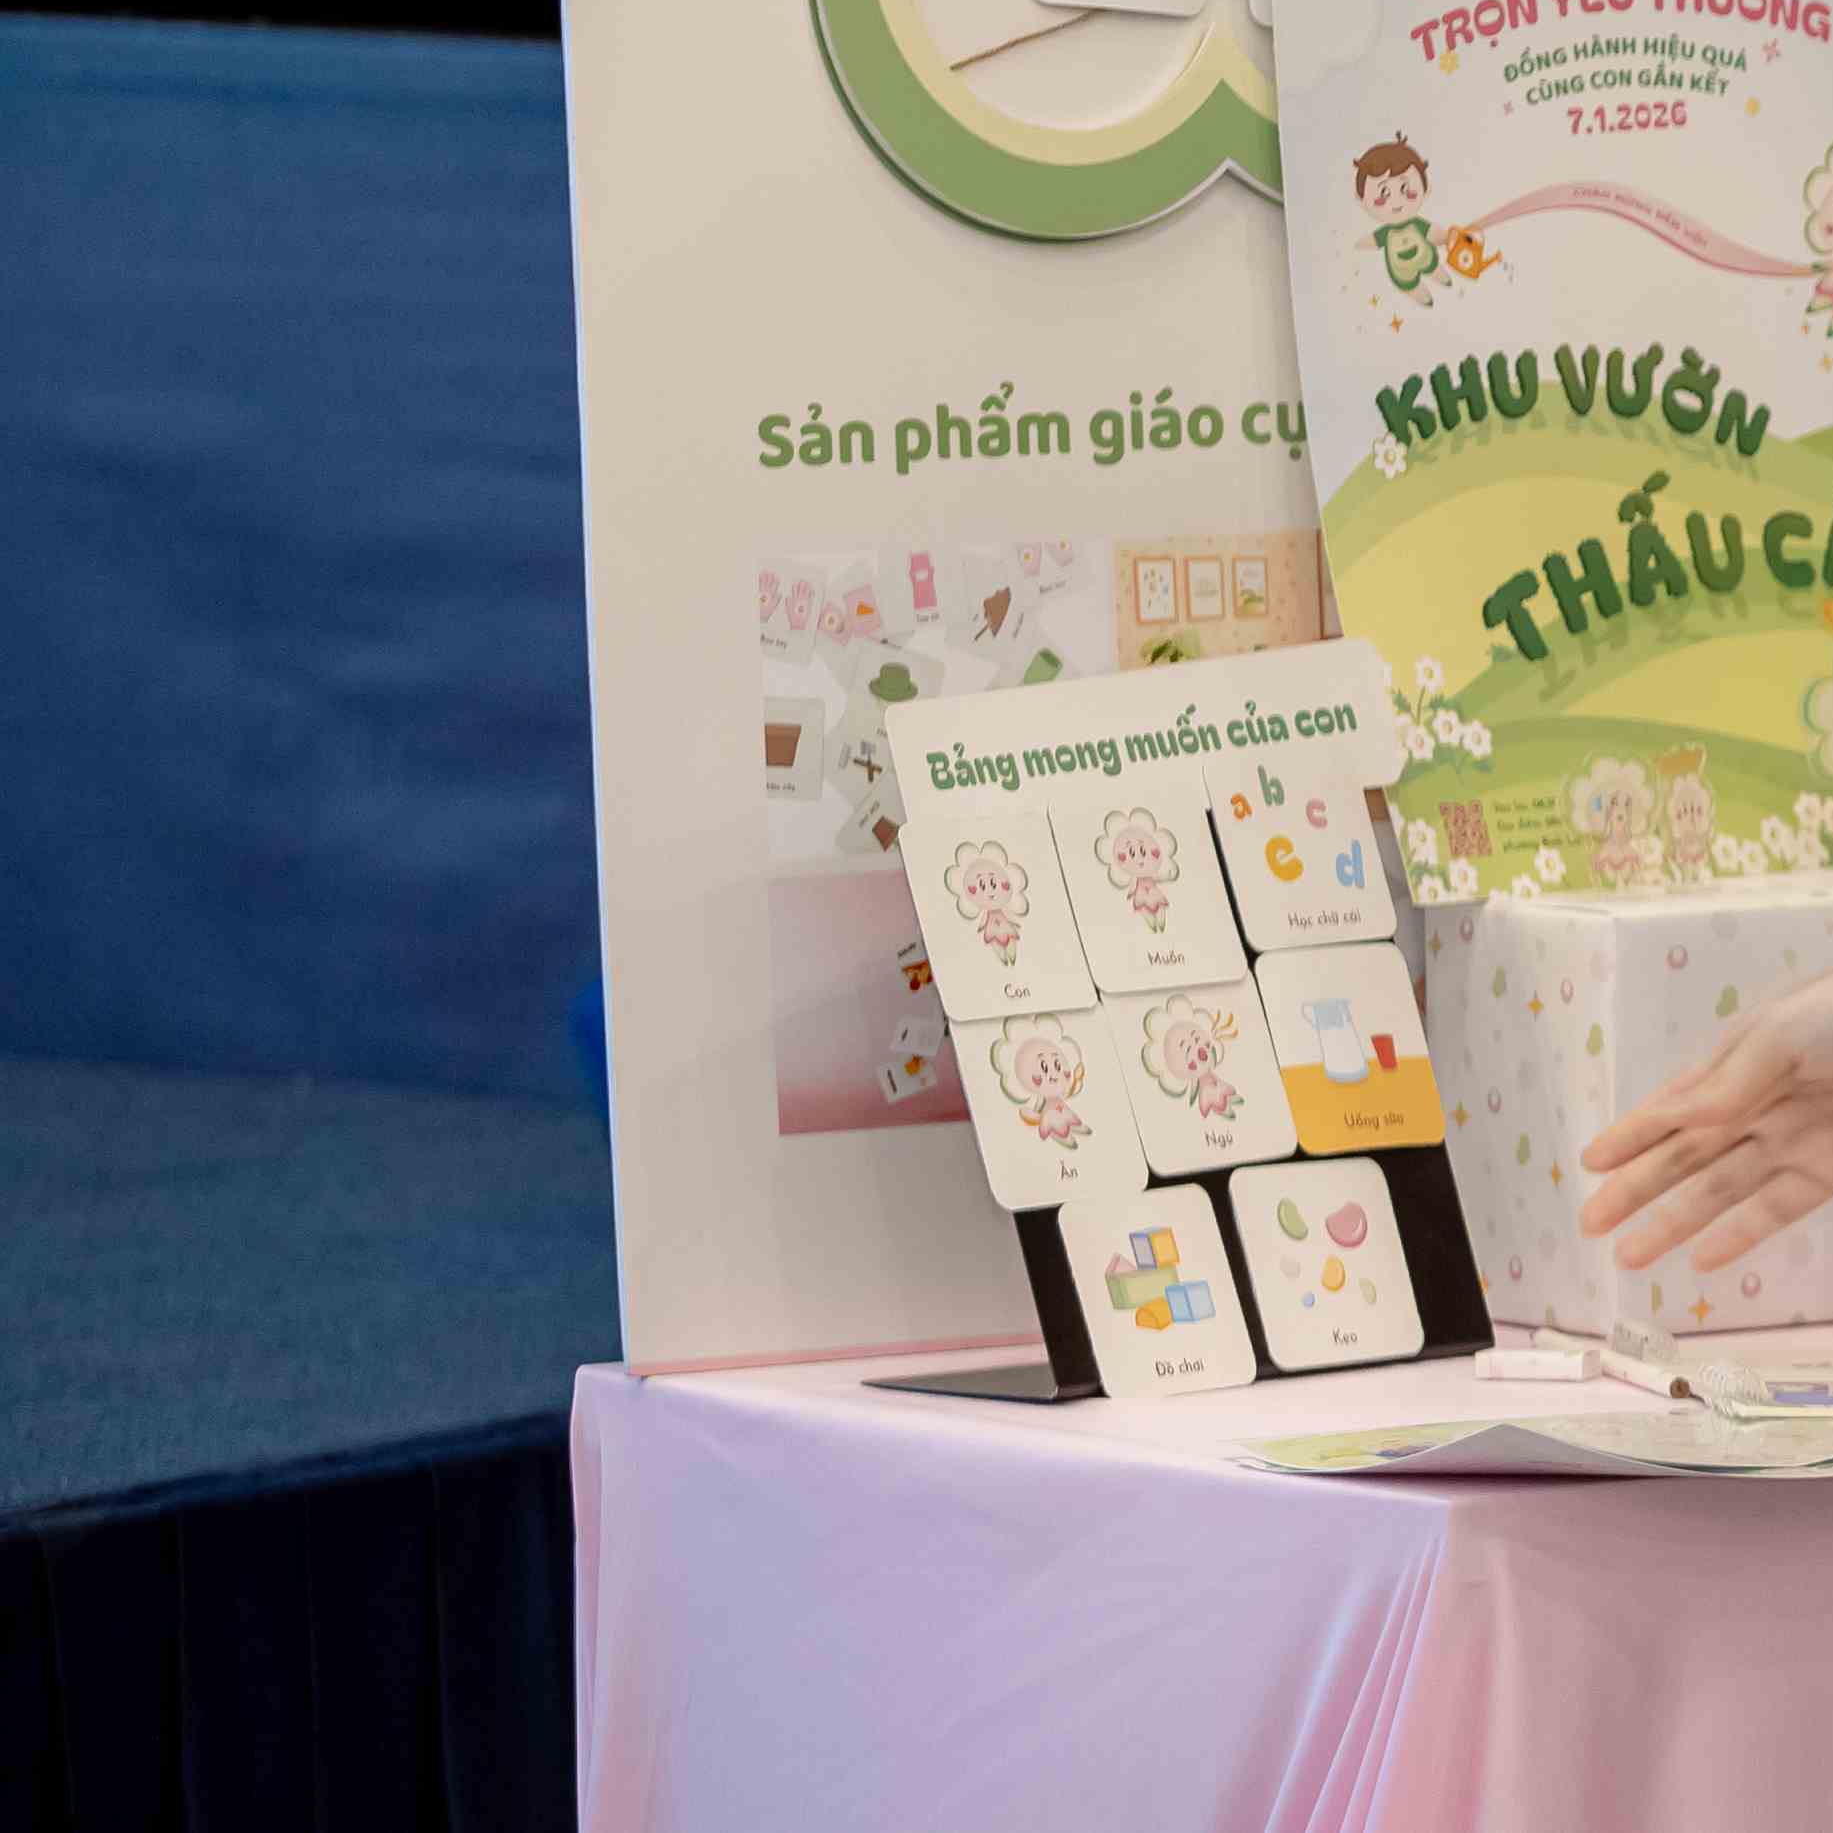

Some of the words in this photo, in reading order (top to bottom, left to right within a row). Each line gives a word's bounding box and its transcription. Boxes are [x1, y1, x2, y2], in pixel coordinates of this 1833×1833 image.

[1504, 40, 1569, 84] ĐỒNG
[1572, 33, 1637, 63] HÀNH
[1643, 32, 1696, 62] HIỆU
[1525, 72, 1585, 106] CÙNG
[1590, 68, 1634, 91] CON
[1688, 67, 1730, 98] KẾT
[1566, 100, 1689, 137] 7.1.2026
[1375, 348, 1540, 447] KHU
[1554, 341, 1771, 457] VƯỜN
[757, 402, 876, 468] Sản
[894, 380, 1072, 475] phẩm
[1089, 386, 1225, 466] giáo
[1240, 400, 1308, 460] cụ
[1482, 470, 1744, 663] THẤU
[926, 741, 1021, 792] Bảng
[1022, 737, 1123, 779] mong
[1124, 703, 1222, 763] muốn
[1226, 700, 1290, 748] của
[1294, 702, 1359, 739] con
[1002, 982, 1031, 1000] Con
[1331, 1327, 1359, 1347] Kẹo
